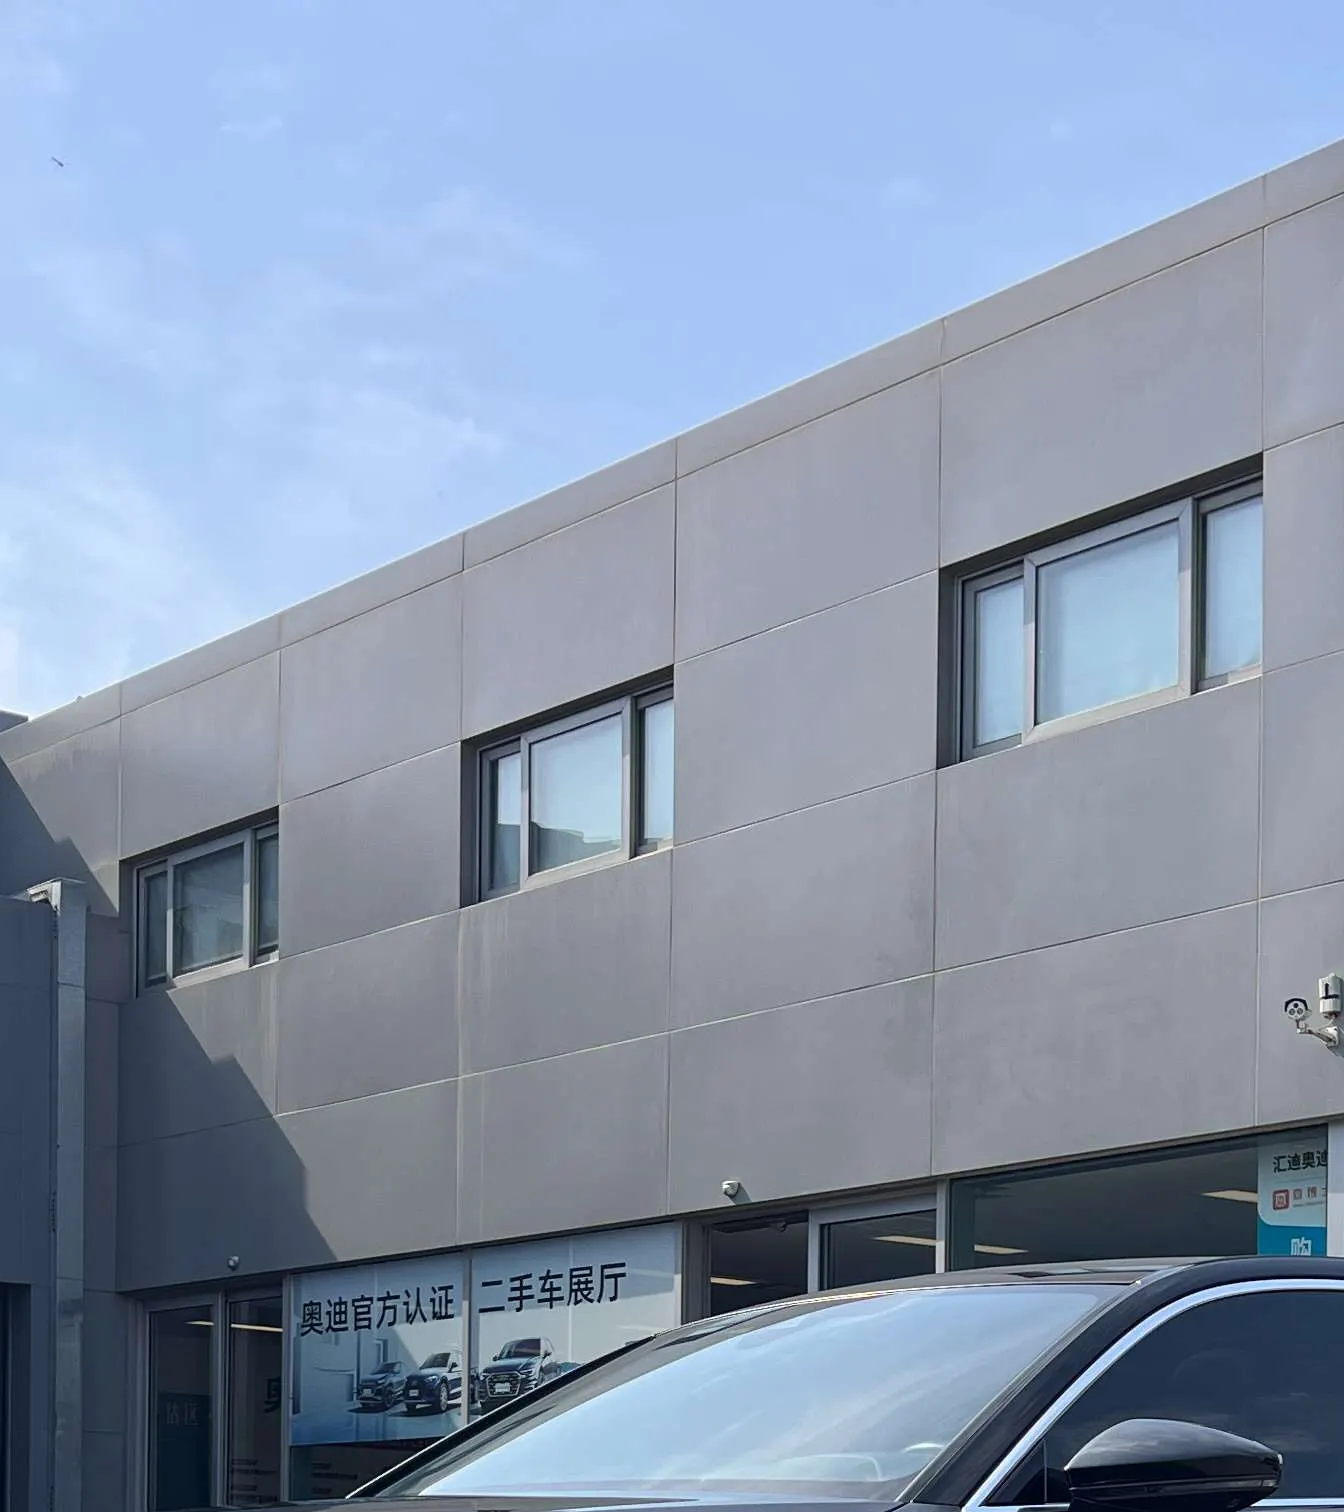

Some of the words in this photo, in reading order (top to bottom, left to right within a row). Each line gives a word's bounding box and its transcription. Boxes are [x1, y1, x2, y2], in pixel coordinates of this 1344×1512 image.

[300, 1285, 455, 1337] 奥迪官方认证
[478, 1262, 627, 1315] 二手车展厅
